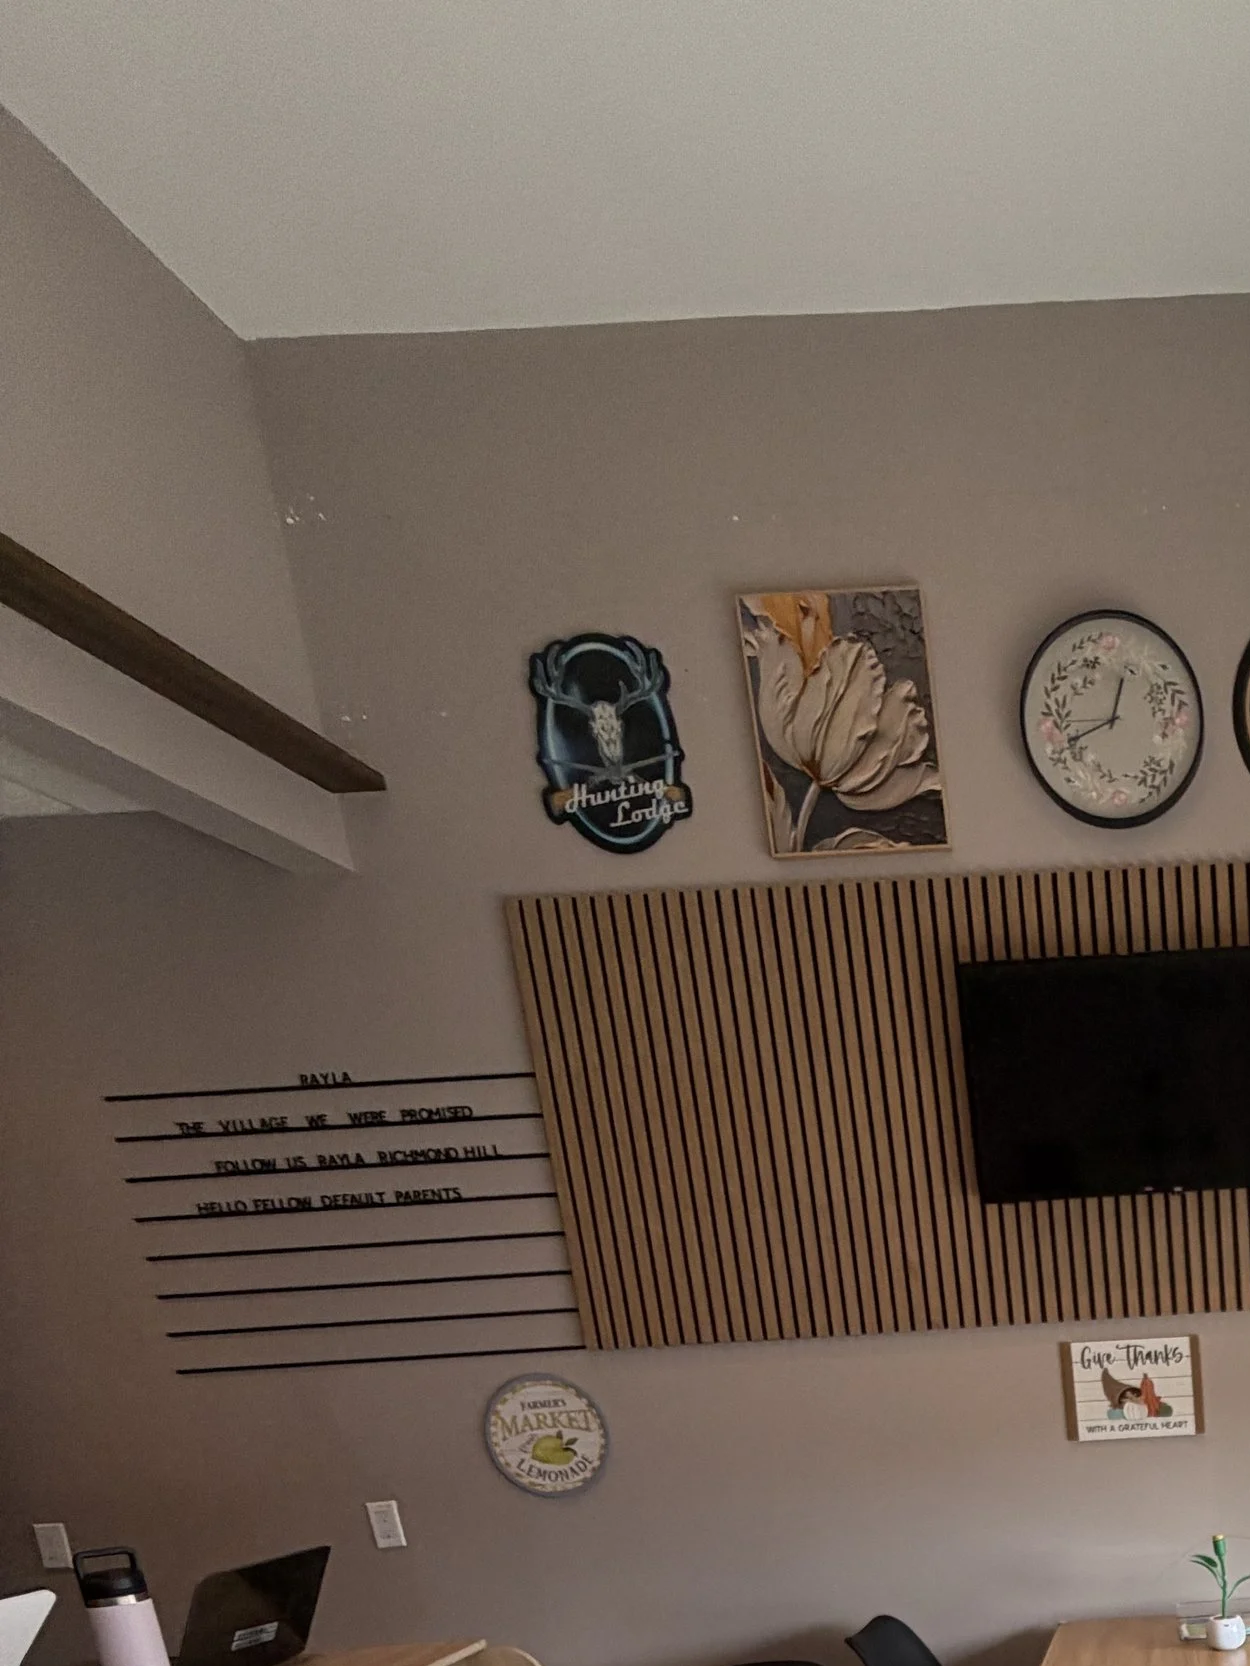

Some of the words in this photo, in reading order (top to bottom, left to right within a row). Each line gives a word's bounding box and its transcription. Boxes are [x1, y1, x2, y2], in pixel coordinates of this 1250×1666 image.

[564, 775, 669, 814] Hunting
[609, 799, 689, 828] Lodge
[299, 1071, 352, 1086] RAYLA
[175, 1121, 205, 1135] THE
[218, 1115, 288, 1133] VILLAGE
[305, 1113, 328, 1128] WE
[348, 1110, 387, 1125] WERE
[400, 1105, 473, 1122] PROMISED
[215, 1157, 277, 1173] FOLLOW
[284, 1155, 307, 1169] US
[317, 1152, 365, 1167] RAYLA
[377, 1146, 459, 1164] RICHMOND
[463, 1144, 503, 1159] HILL
[196, 1199, 247, 1214] HELLO
[252, 1195, 312, 1211] FELLOW
[320, 1190, 386, 1208] DEFAULT
[394, 1186, 463, 1203] PARENTS
[1081, 1345, 1115, 1369] Give
[1116, 1344, 1183, 1370] Thanks
[498, 1409, 596, 1442] MARKET
[1085, 1425, 1107, 1434] WITH
[1118, 1421, 1159, 1432] GRATEFUL
[1161, 1420, 1188, 1430] HEART
[516, 1454, 595, 1482] LEMONADE
